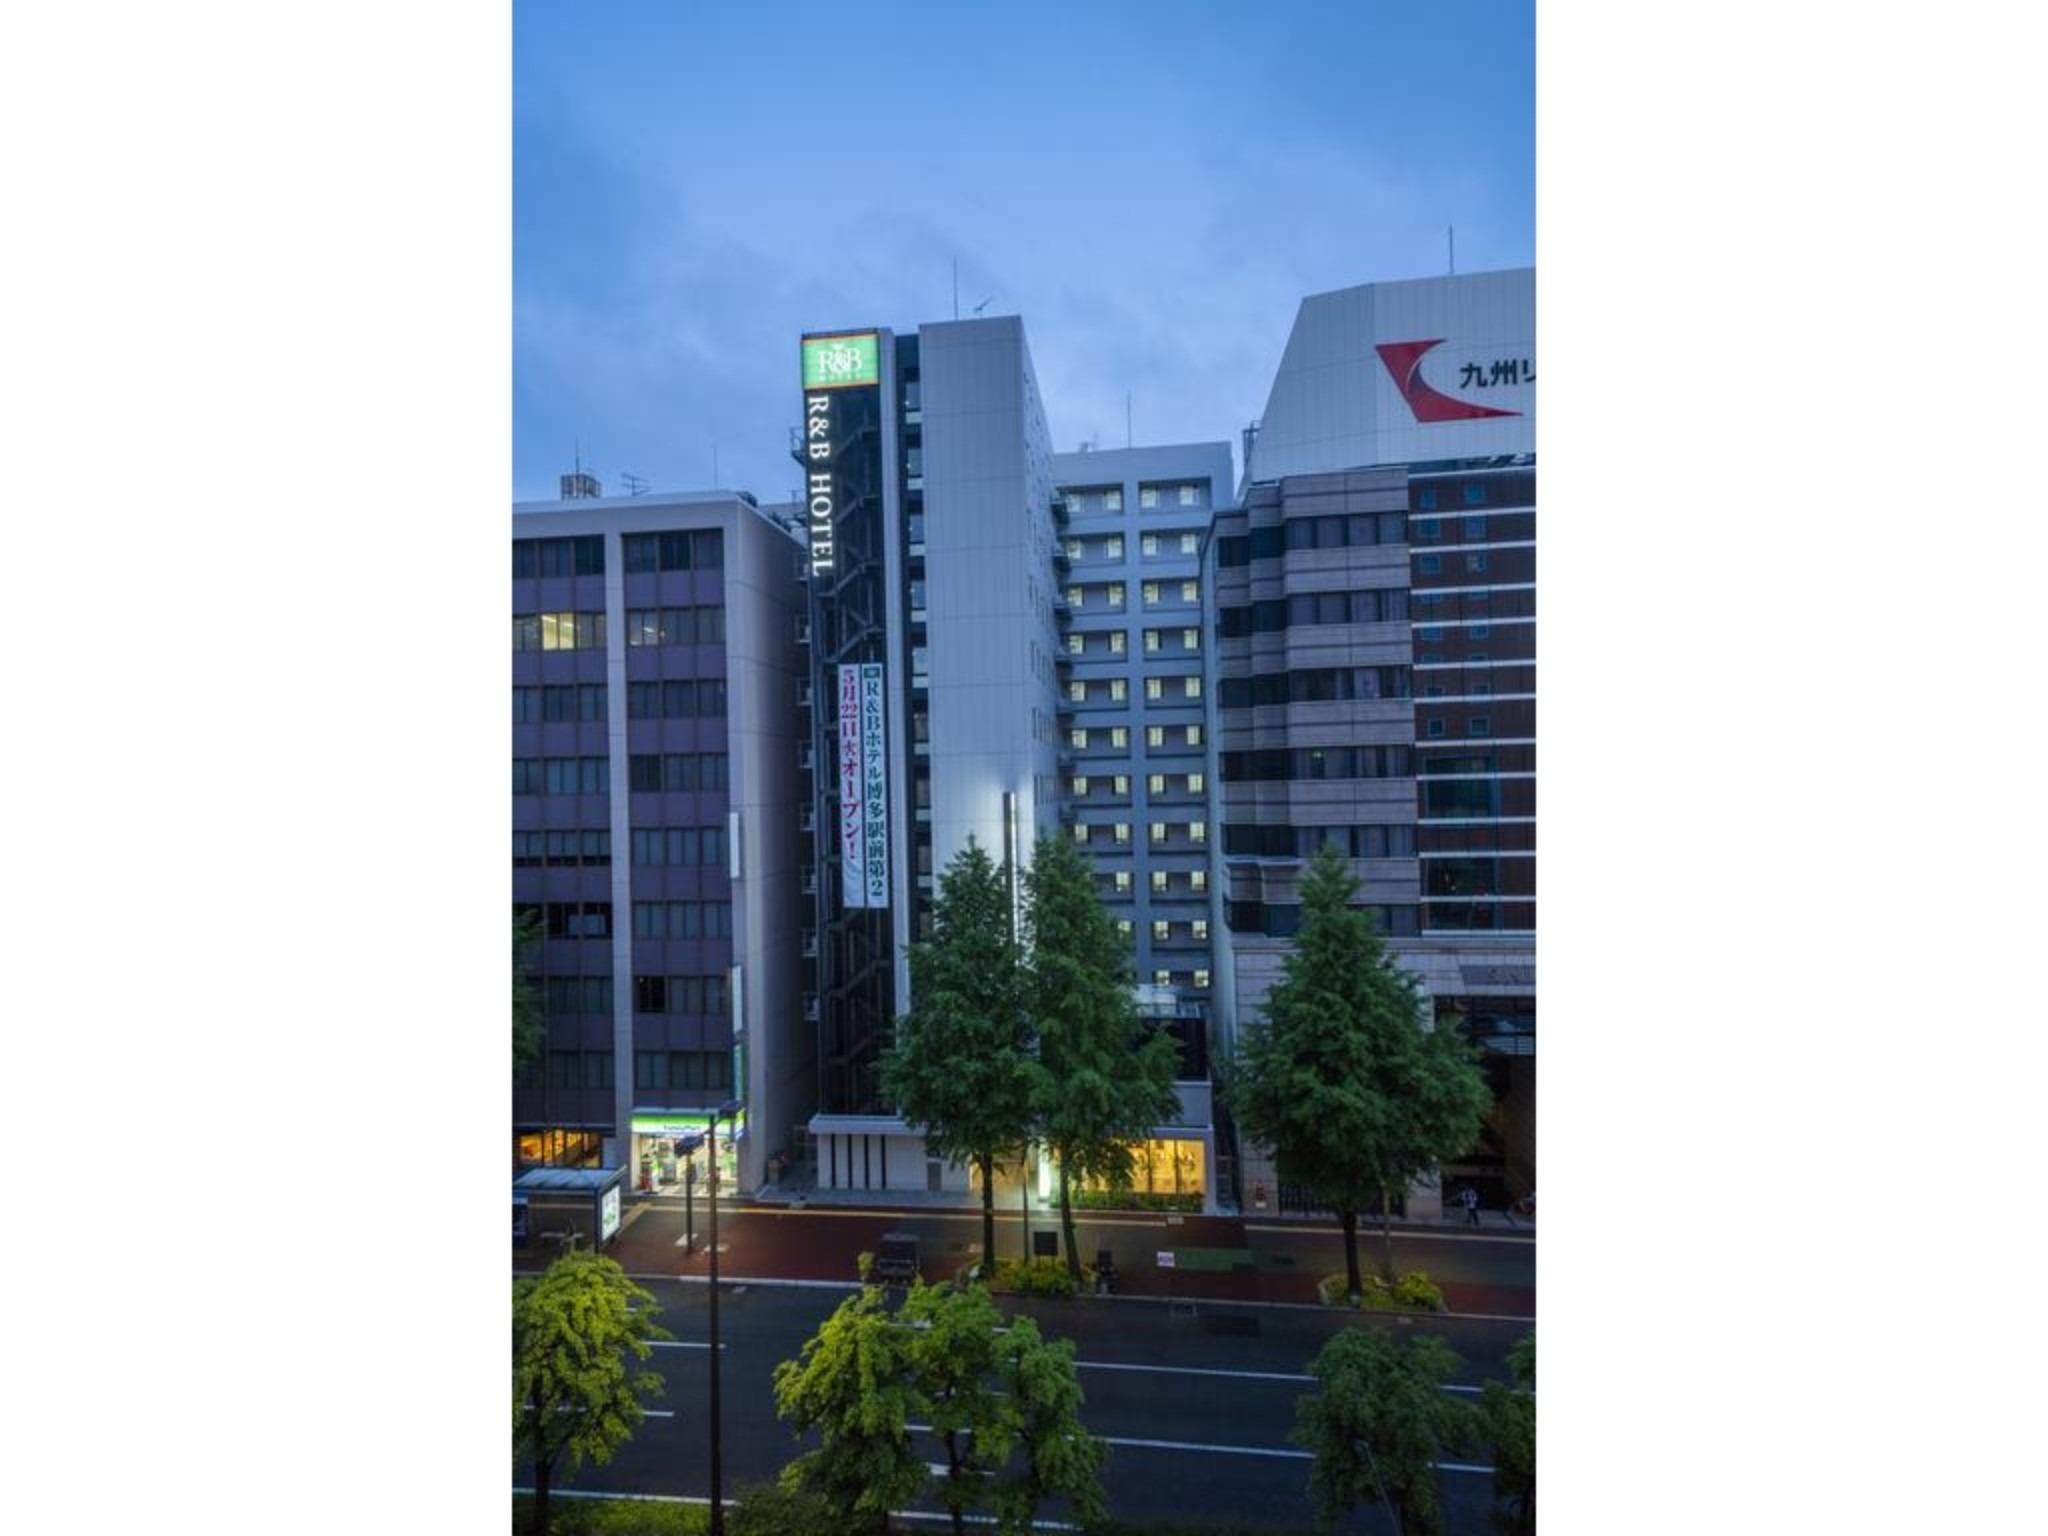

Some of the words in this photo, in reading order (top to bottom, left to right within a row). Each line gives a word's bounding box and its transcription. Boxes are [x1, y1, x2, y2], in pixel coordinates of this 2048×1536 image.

[818, 347, 863, 375] R&B
[809, 396, 830, 459] R&B
[810, 473, 833, 576] HOTEL
